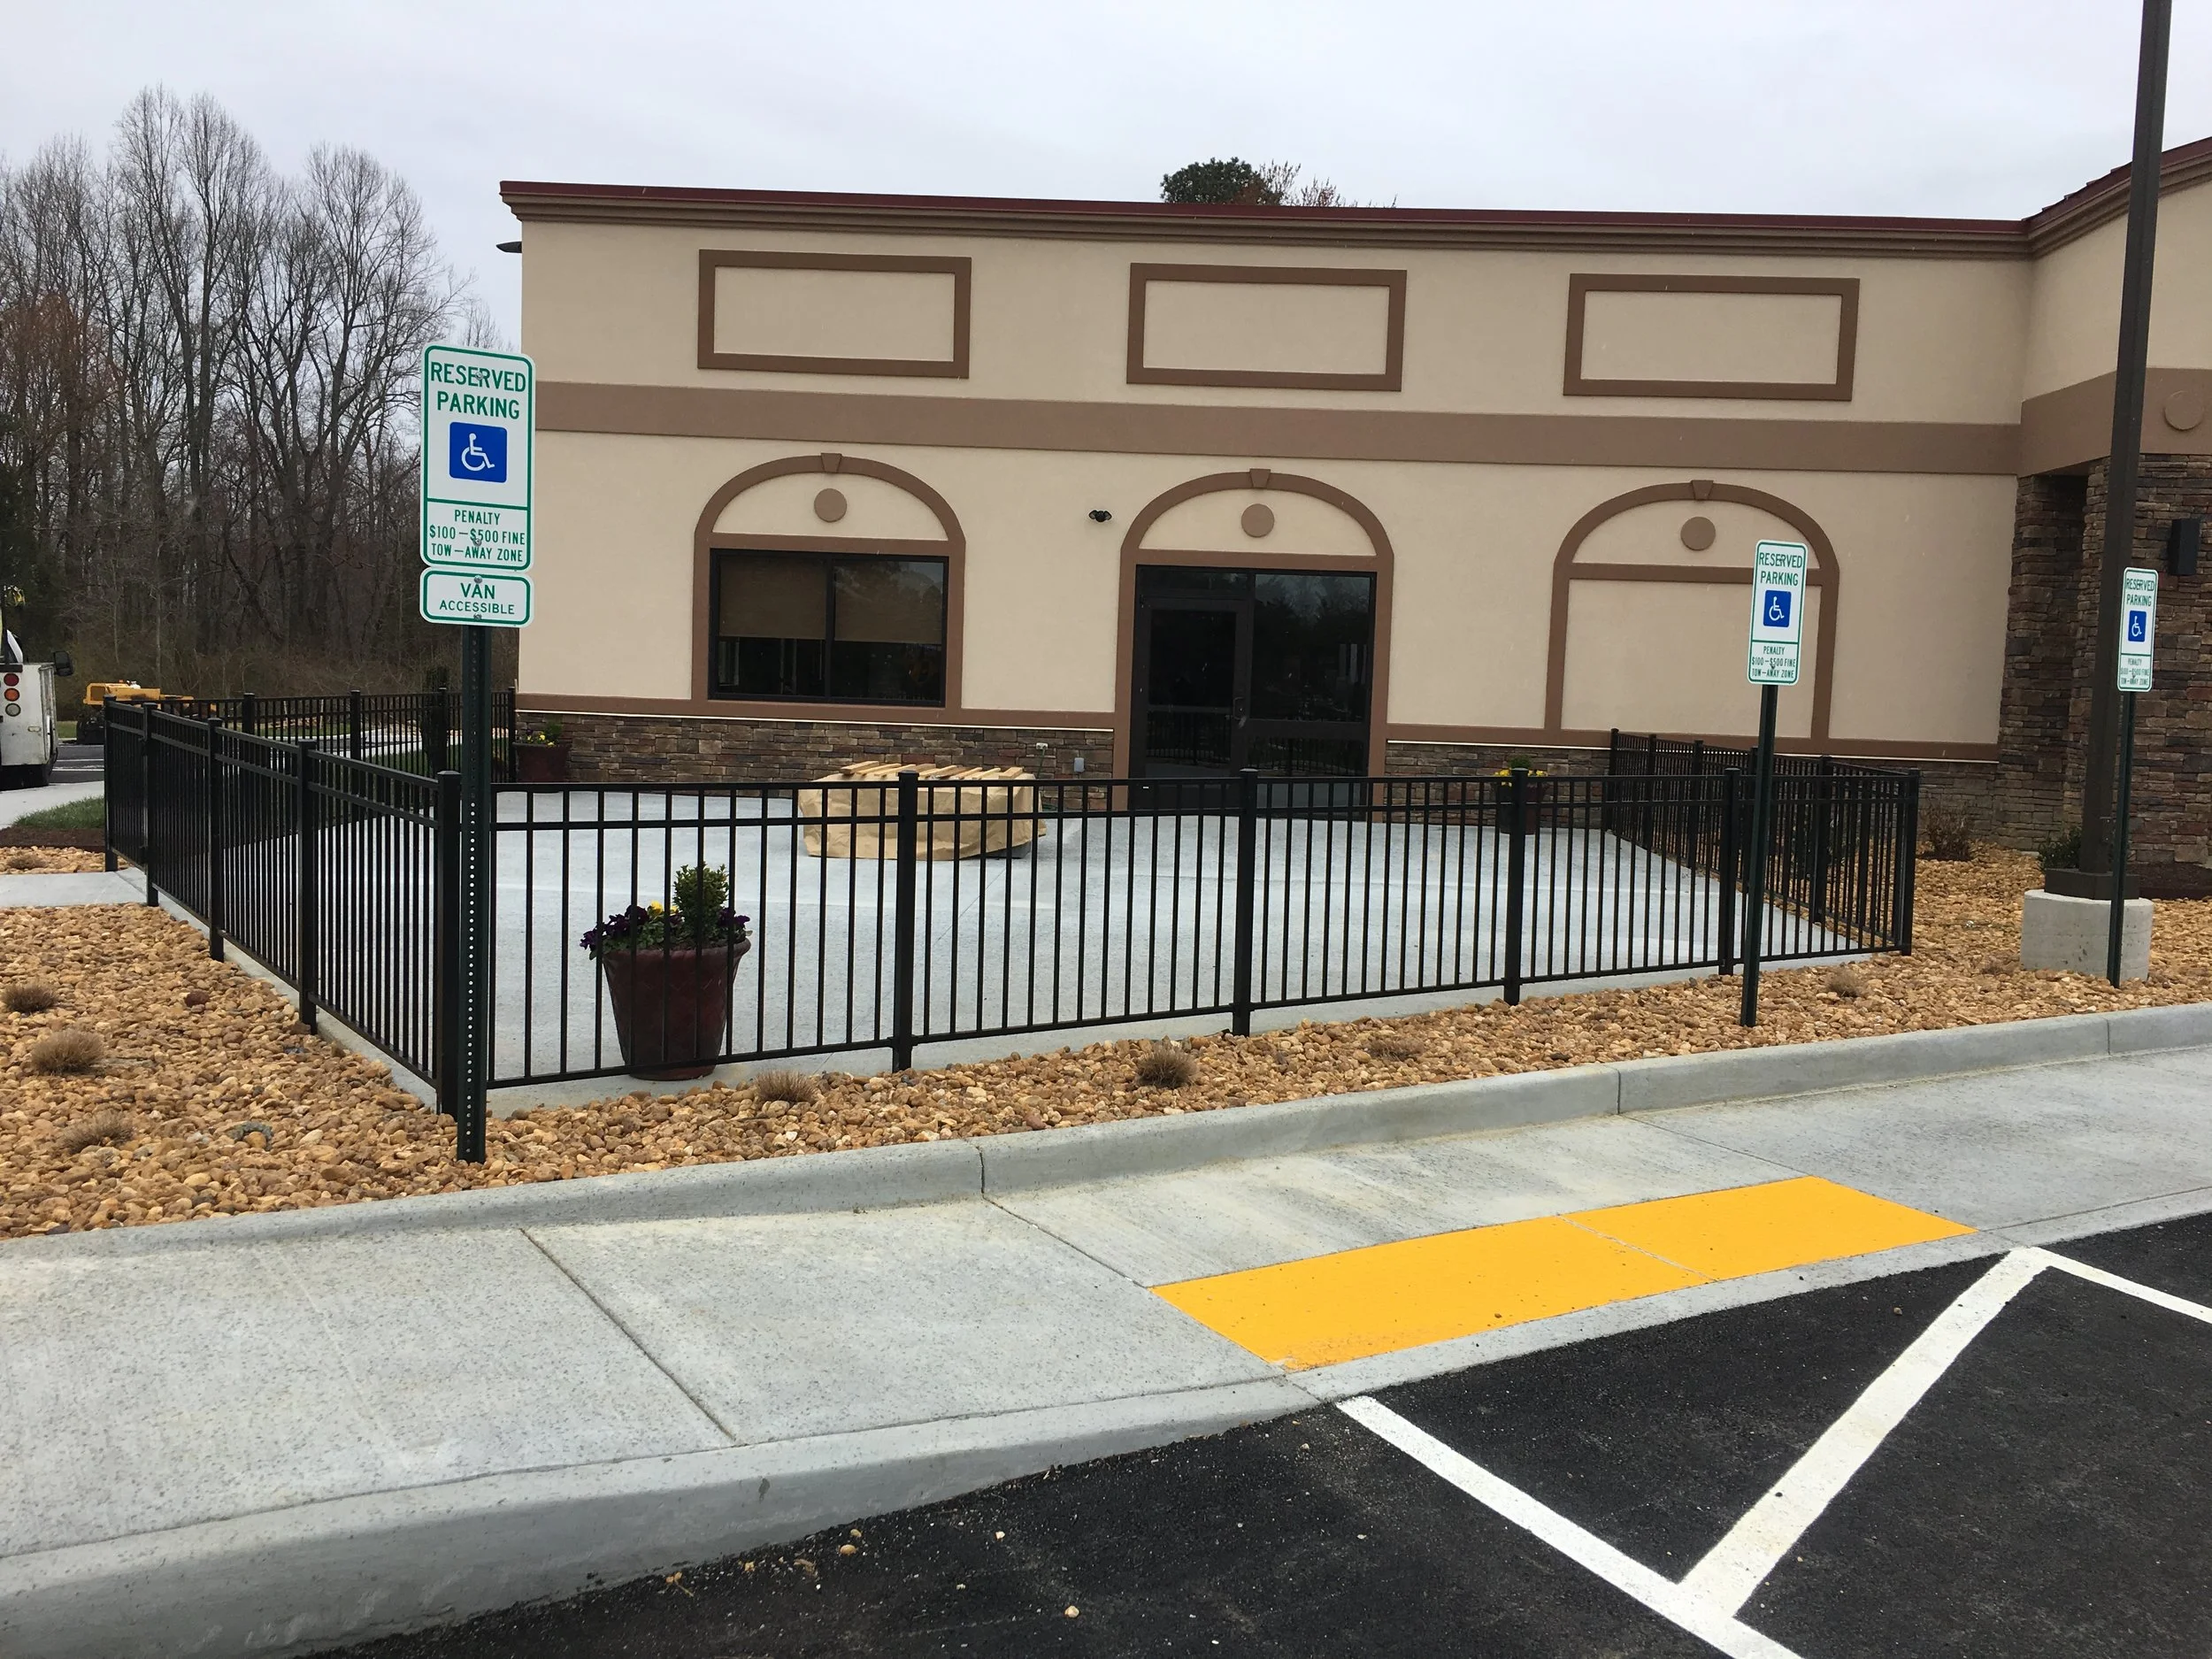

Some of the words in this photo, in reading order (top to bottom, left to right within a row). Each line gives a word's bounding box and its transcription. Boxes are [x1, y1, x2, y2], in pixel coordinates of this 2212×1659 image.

[431, 361, 526, 393] RESERVED
[437, 390, 519, 419] PARKING
[454, 509, 501, 526] PENALTY
[502, 530, 526, 545] FINE
[497, 548, 523, 562] ZONE
[1759, 552, 1803, 568] RESERVED
[1760, 571, 1799, 586] PARKING
[2125, 578, 2155, 592] RESERVED
[460, 582, 495, 599] VAN
[439, 600, 515, 615] ACCESSIBLE
[2126, 594, 2152, 606] PARKING
[1763, 645, 1786, 655] PENALTY
[1785, 658, 1795, 667] FINE
[1781, 669, 1793, 678] ZONE
